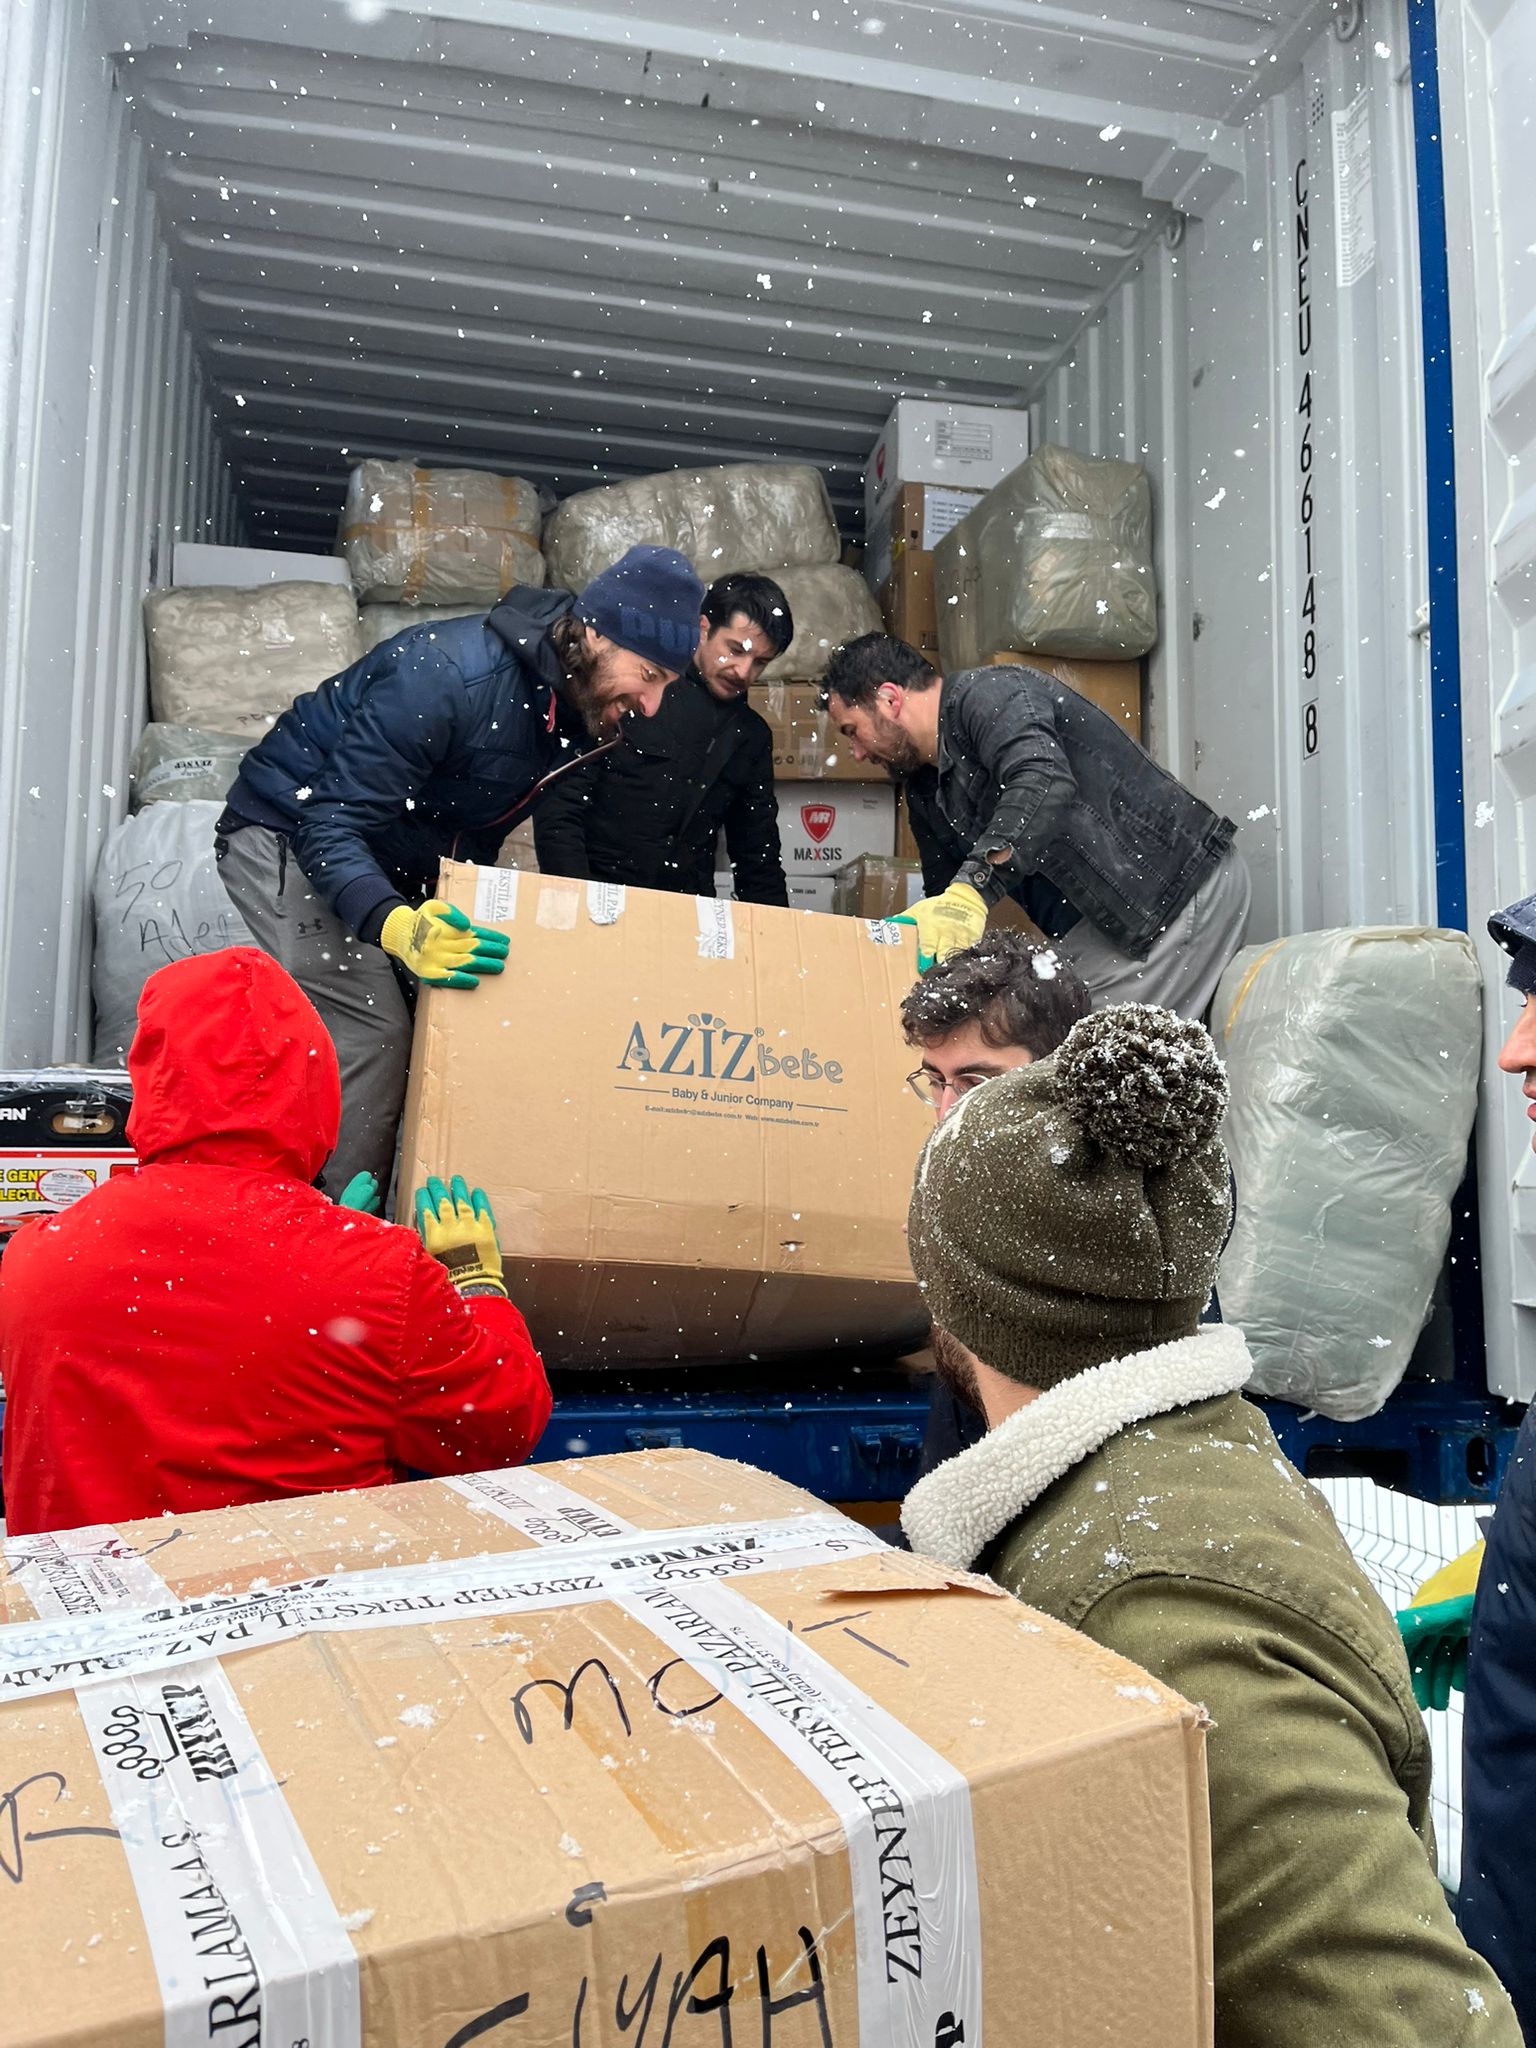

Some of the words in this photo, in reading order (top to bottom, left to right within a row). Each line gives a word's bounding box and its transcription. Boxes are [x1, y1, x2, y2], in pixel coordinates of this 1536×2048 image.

[1298, 372, 1317, 679] 466148
[1303, 704, 1318, 755] 8
[794, 847, 842, 861] MAXSIS
[671, 1088, 698, 1101] Baby
[700, 1090, 709, 1100] &
[711, 1091, 743, 1104] Junior
[745, 1095, 794, 1111] Company
[453, 1576, 604, 1605] ZEYNEP
[259, 1593, 446, 1627] TEKSTİL
[840, 1770, 921, 1985] ZEYNEP
